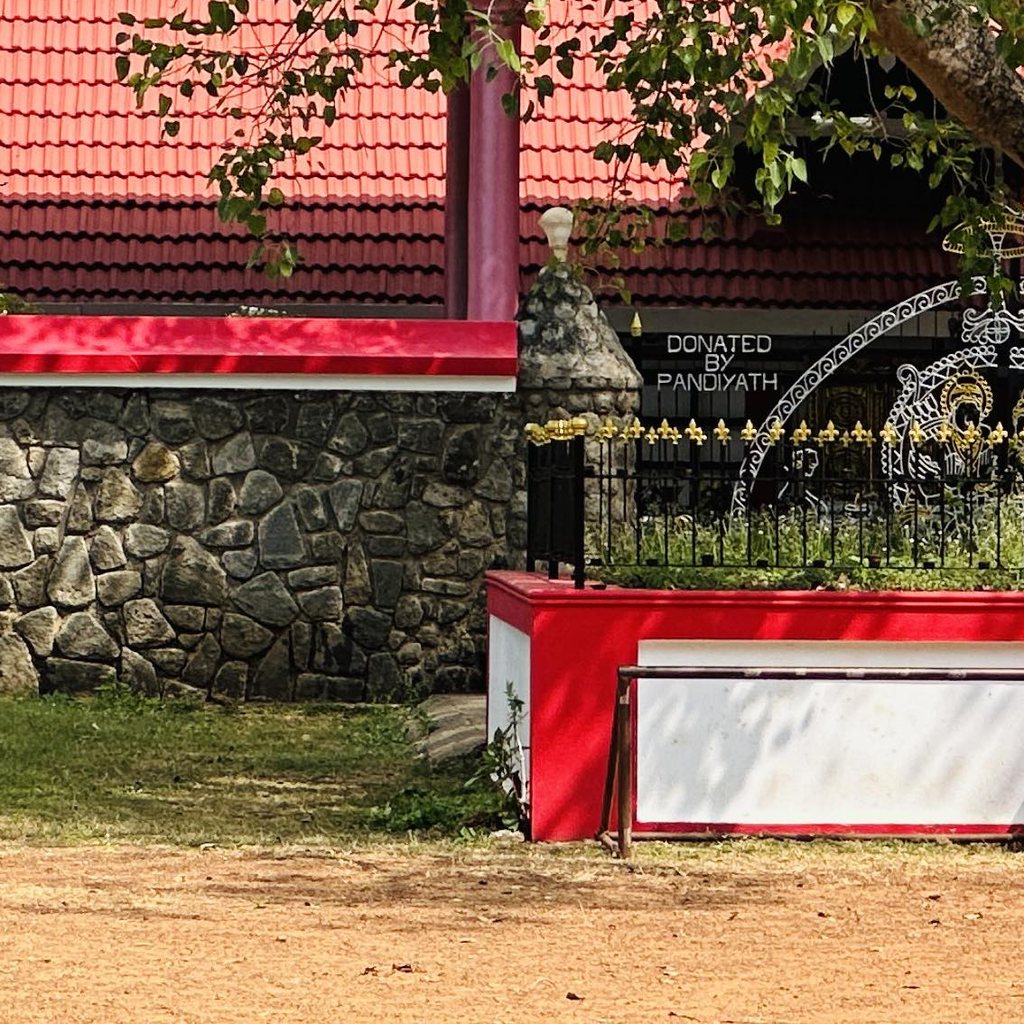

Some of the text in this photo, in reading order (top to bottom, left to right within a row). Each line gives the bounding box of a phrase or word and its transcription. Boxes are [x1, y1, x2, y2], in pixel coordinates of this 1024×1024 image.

[667, 334, 772, 353] DONATED
[704, 353, 735, 372] BY
[657, 372, 778, 392] PANDIYATH
